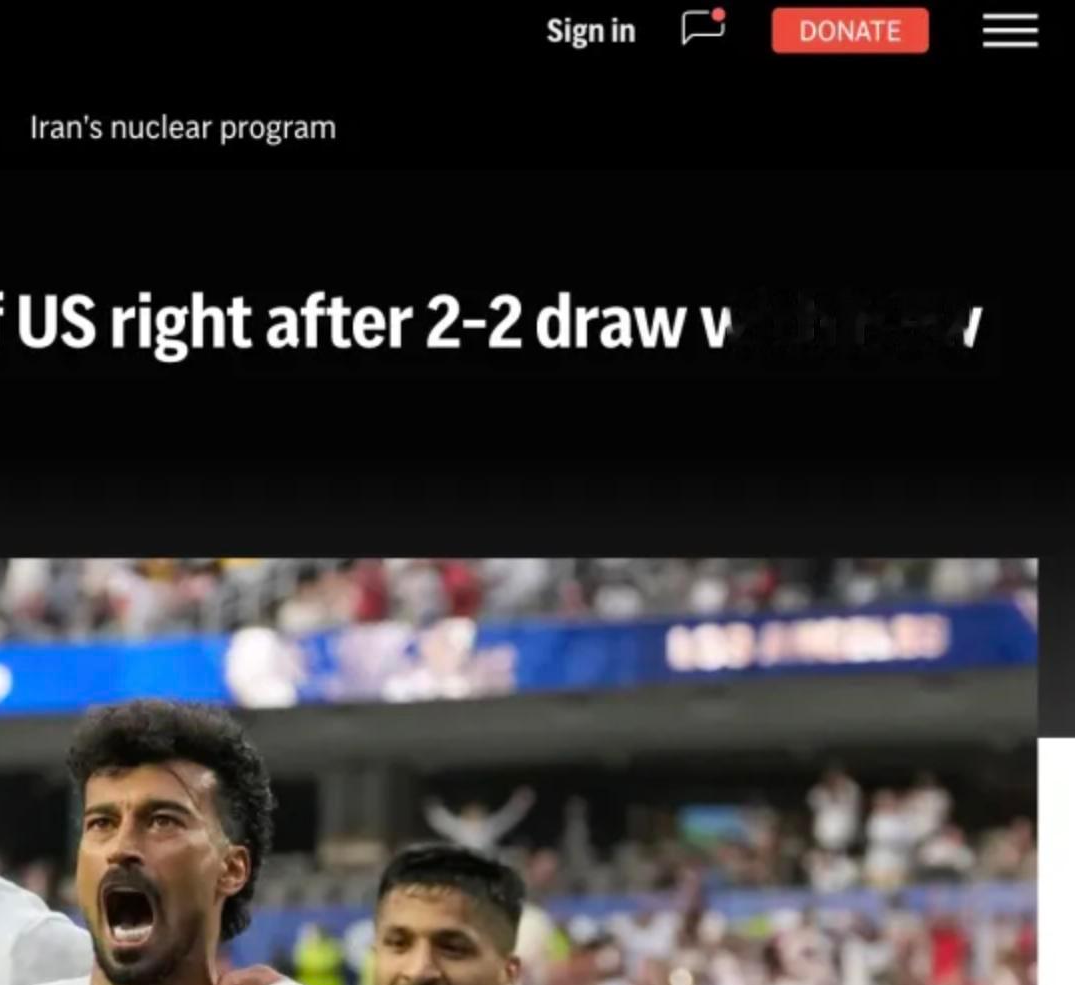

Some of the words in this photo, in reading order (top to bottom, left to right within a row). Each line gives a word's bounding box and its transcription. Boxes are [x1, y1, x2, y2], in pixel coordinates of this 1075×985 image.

[547, 18, 604, 49] Sign
[612, 18, 635, 42] in
[799, 19, 902, 43] DONATE
[32, 114, 102, 139] Iran's
[112, 114, 212, 139] nuclear
[221, 120, 335, 145] program
[19, 294, 96, 348] US
[113, 292, 252, 362] right
[267, 291, 413, 348] after
[427, 294, 521, 348] 2-2
[537, 292, 687, 348] draw
